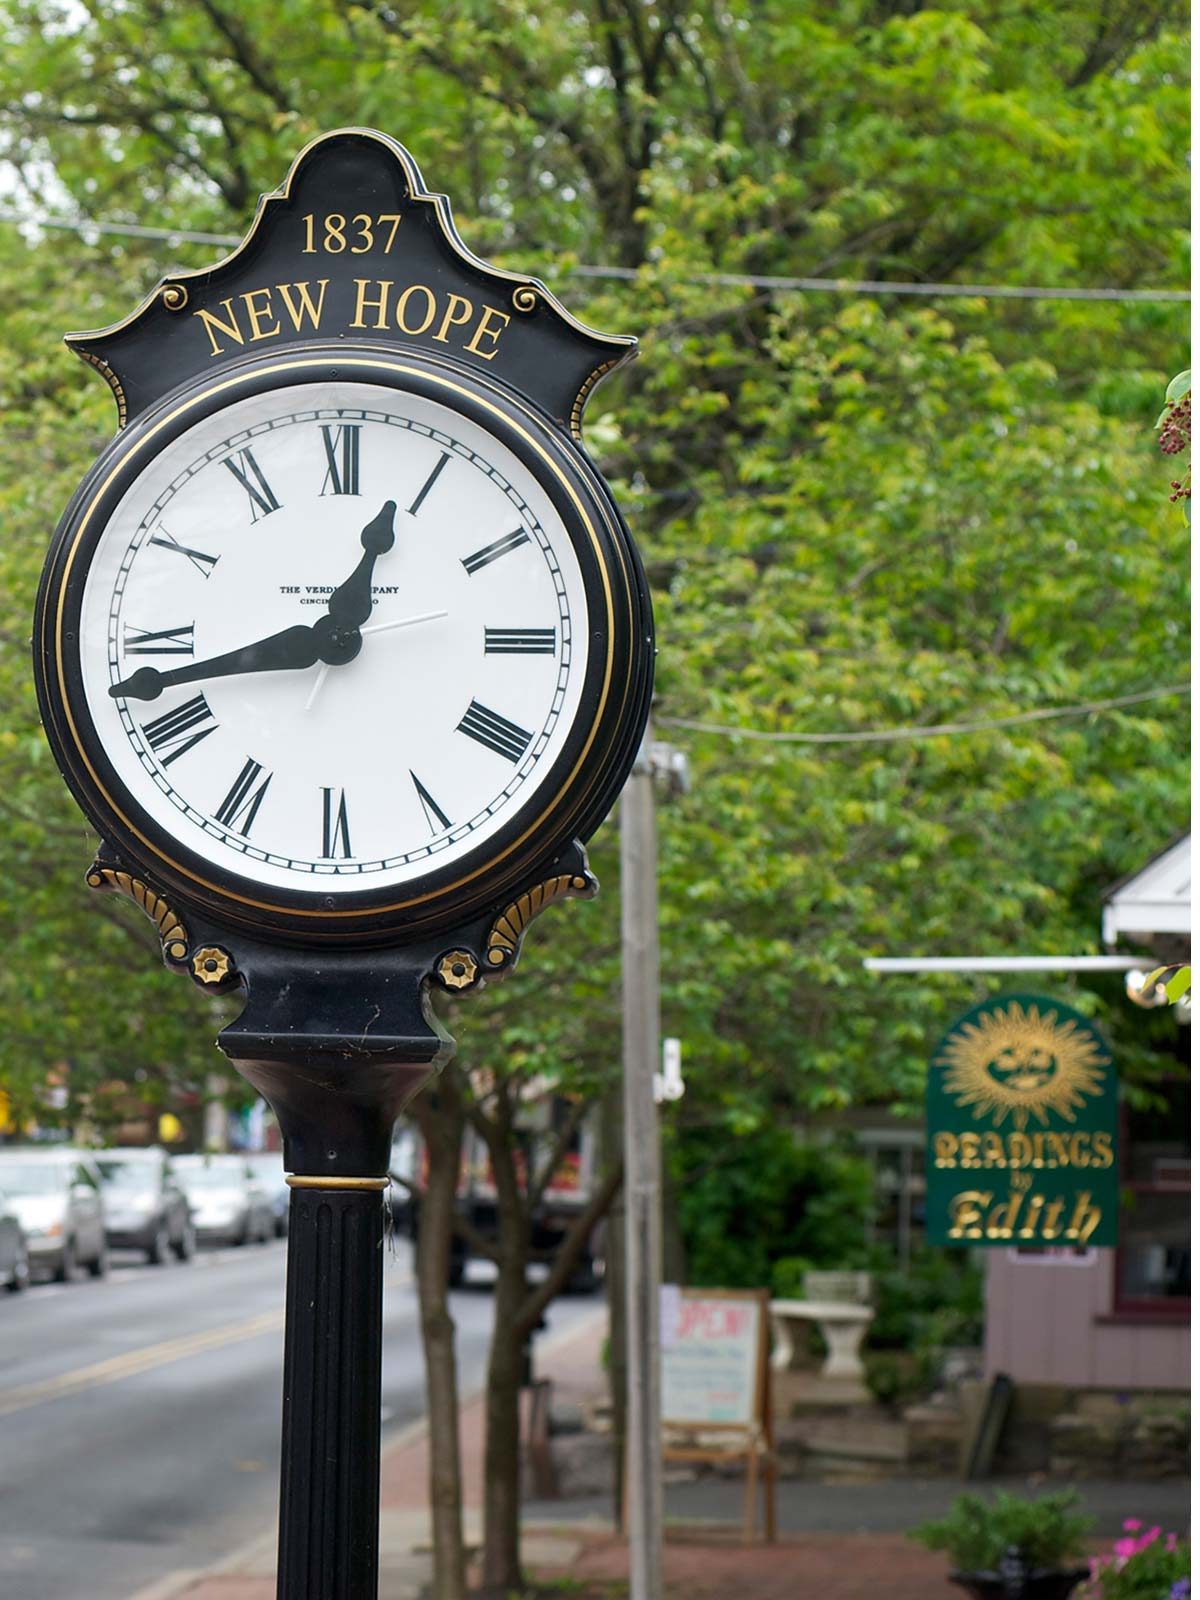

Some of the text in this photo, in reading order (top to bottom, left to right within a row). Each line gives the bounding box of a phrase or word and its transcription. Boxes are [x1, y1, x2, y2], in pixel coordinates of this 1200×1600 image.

[301, 213, 401, 254] 1837
[193, 279, 511, 360] NEW HOPE
[218, 444, 284, 525] XI
[318, 424, 363, 496] XII
[405, 450, 453, 517] I
[146, 520, 221, 579] X
[459, 524, 532, 577] II
[279, 586, 399, 594] THE VERD PANY
[124, 620, 195, 659] IX
[484, 625, 556, 657] III
[139, 690, 220, 771] VIII
[210, 755, 274, 839] VII
[317, 787, 357, 859] VI
[409, 768, 456, 837] V
[934, 1131, 1115, 1168] READINGS
[947, 1190, 1102, 1244] Edith
